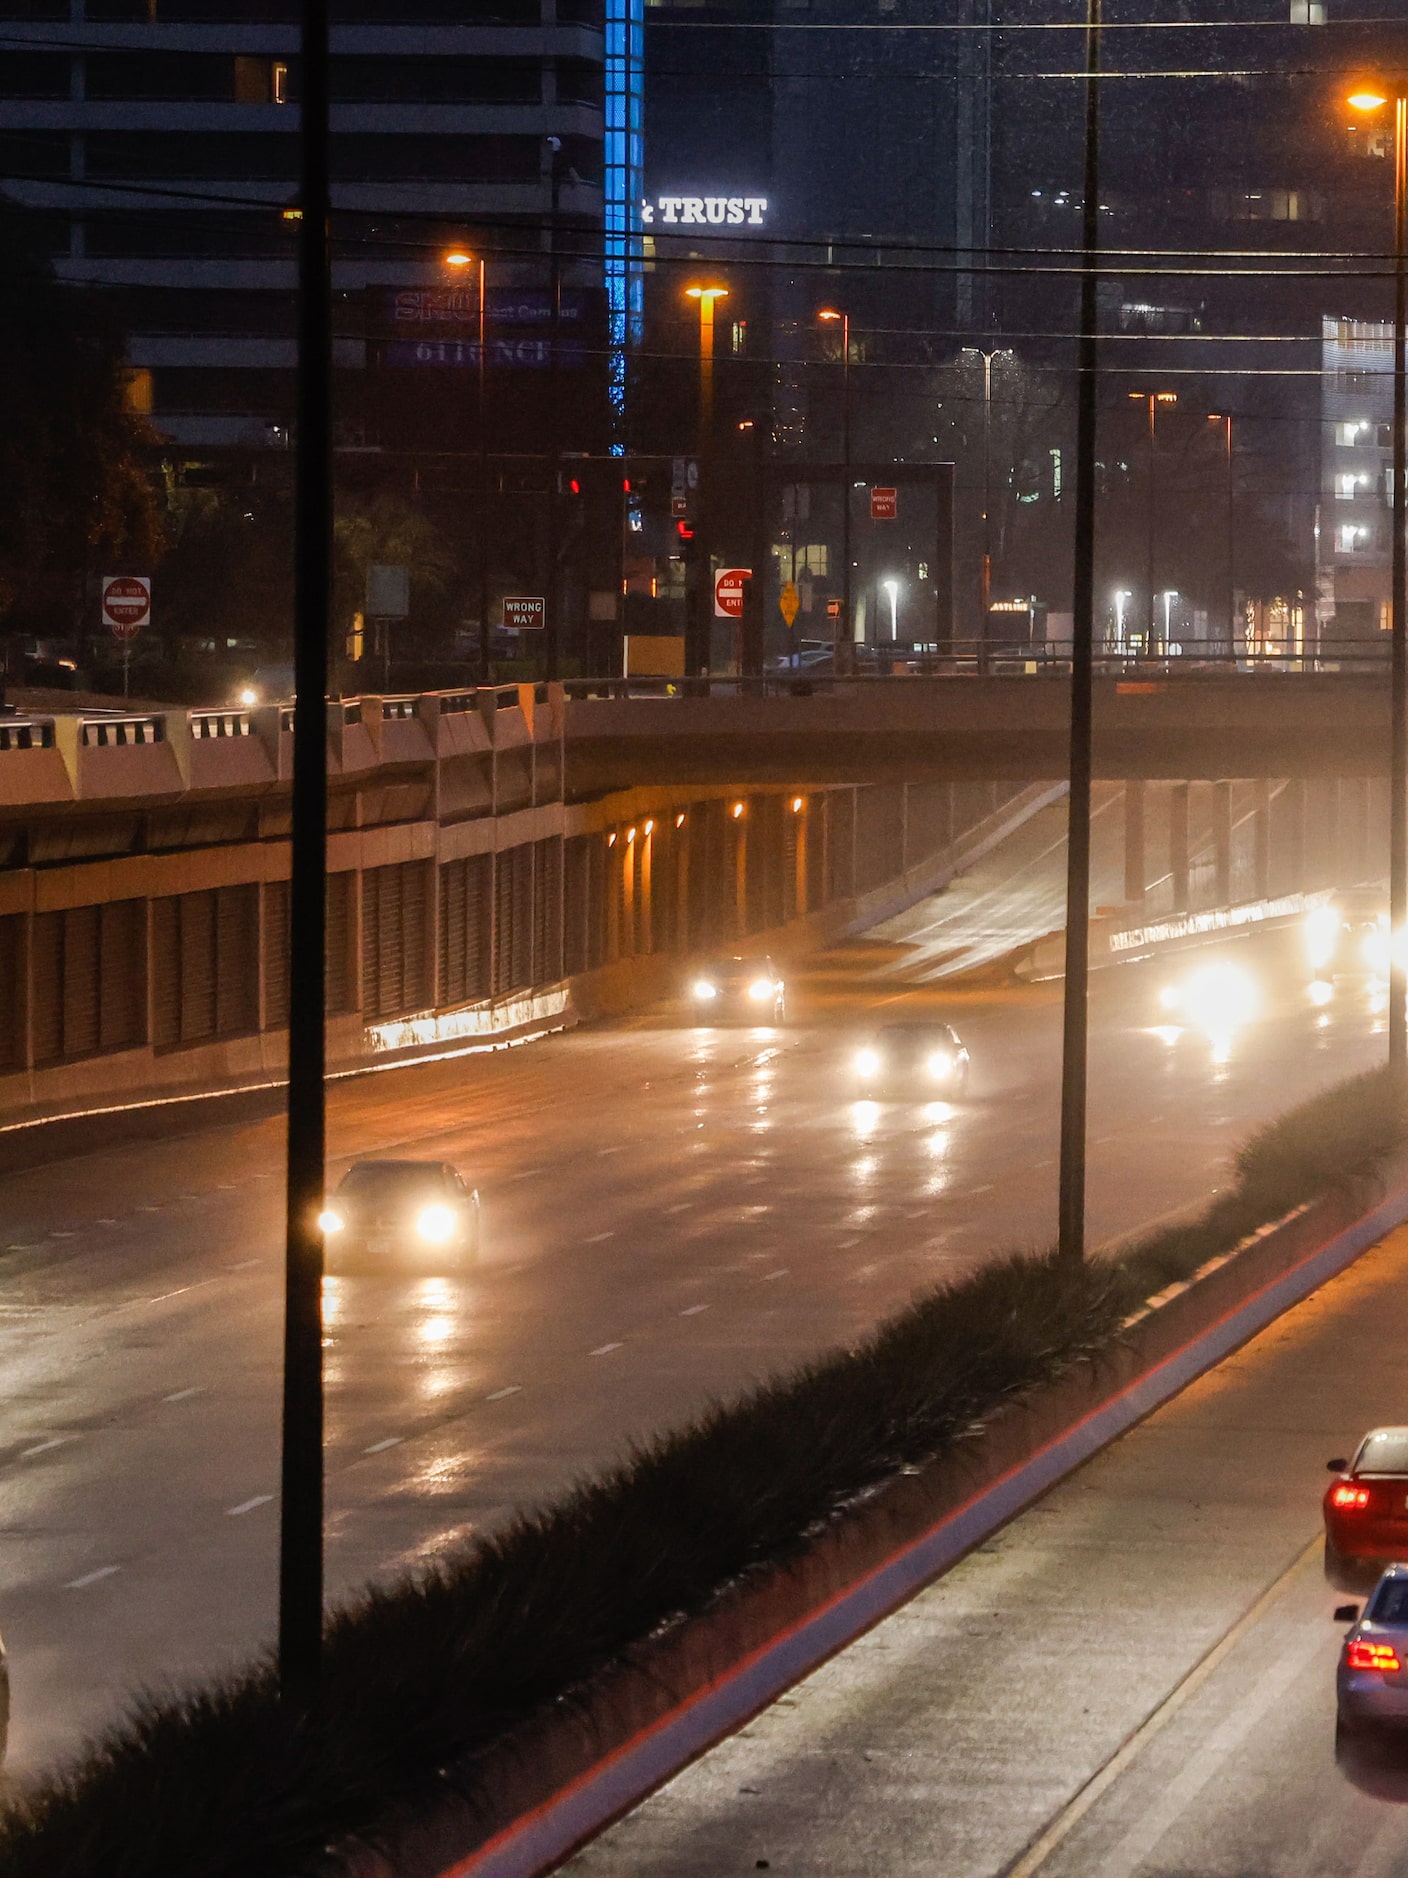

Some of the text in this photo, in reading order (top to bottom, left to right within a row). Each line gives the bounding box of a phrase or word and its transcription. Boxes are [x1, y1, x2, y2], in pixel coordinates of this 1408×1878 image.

[659, 198, 768, 224] TRUST
[518, 305, 578, 320] Camus
[724, 579, 735, 587] DO
[506, 602, 542, 612] WRONG
[726, 599, 744, 607] ENT
[513, 615, 534, 624] WAY
